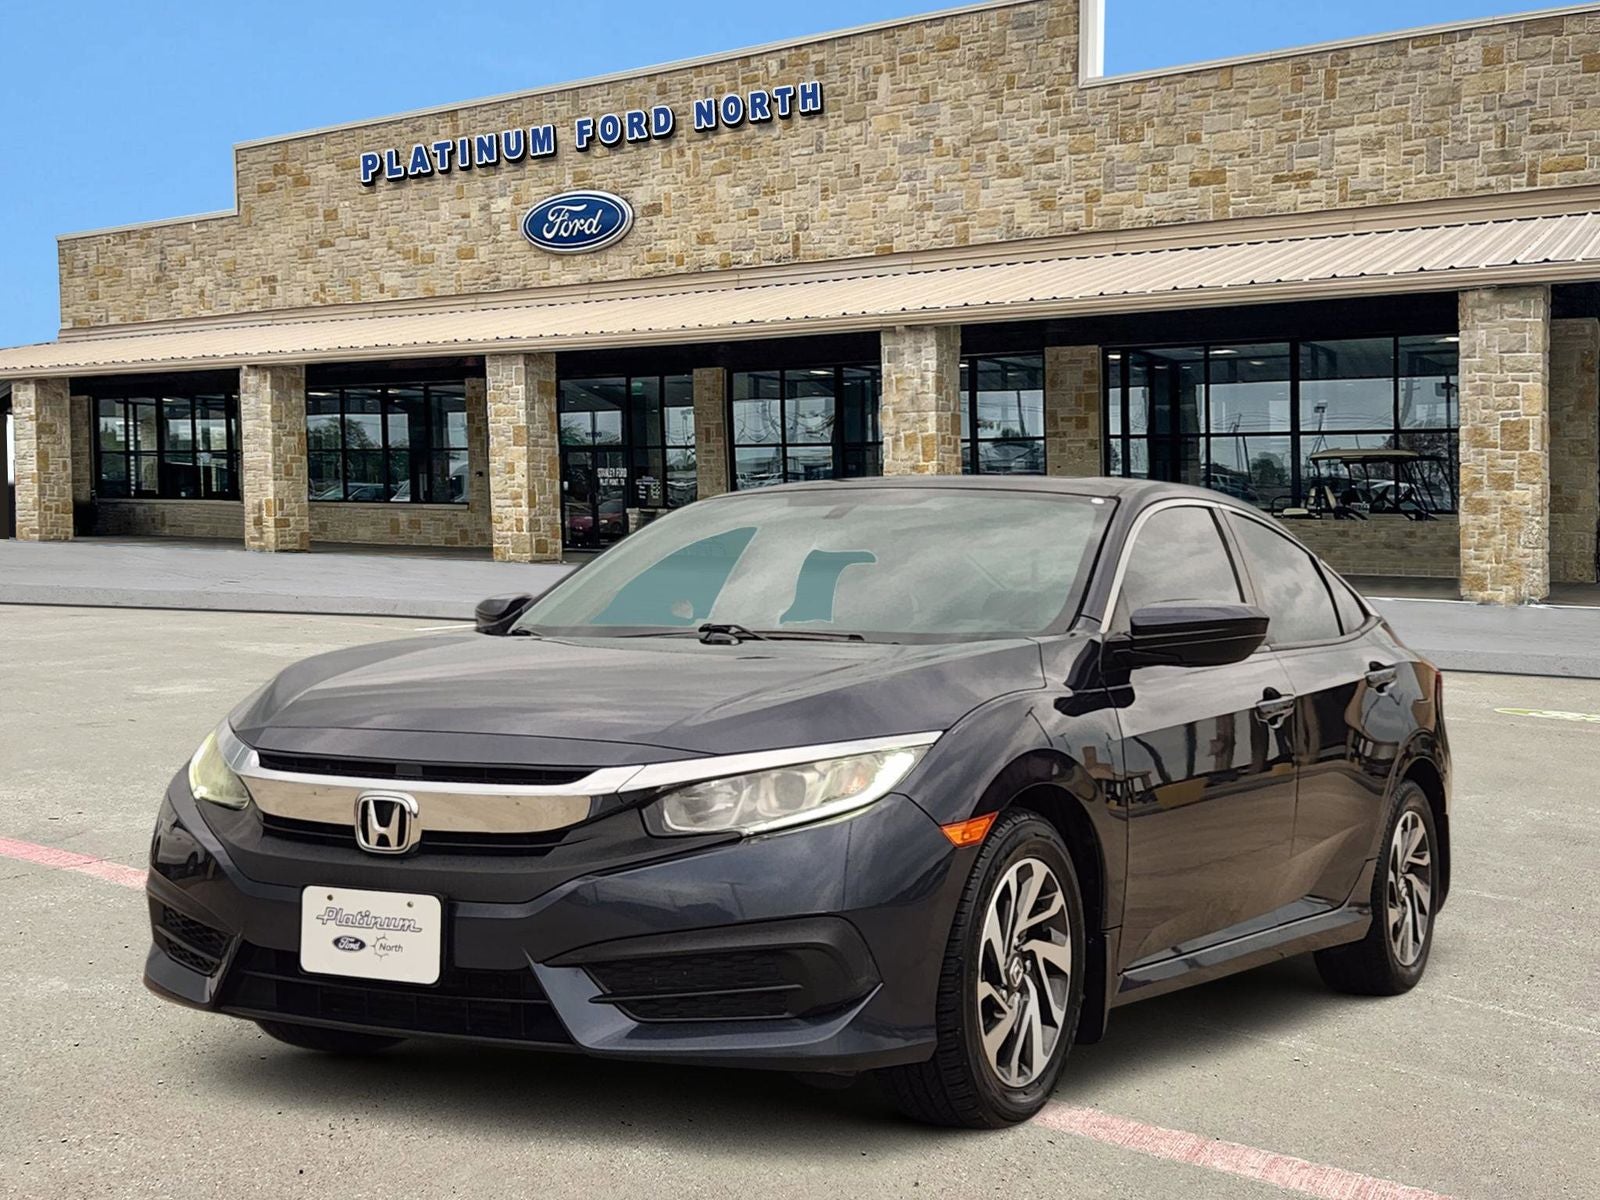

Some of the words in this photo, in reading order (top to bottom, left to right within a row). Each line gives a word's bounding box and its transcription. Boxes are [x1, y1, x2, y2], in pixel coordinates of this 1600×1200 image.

[360, 124, 557, 186] PLATINUM
[575, 105, 676, 151] FORD
[693, 80, 824, 131] NORTH
[541, 203, 604, 240] Ford
[316, 906, 422, 933] Platinum
[337, 937, 361, 951] Ford
[379, 943, 403, 953] North
